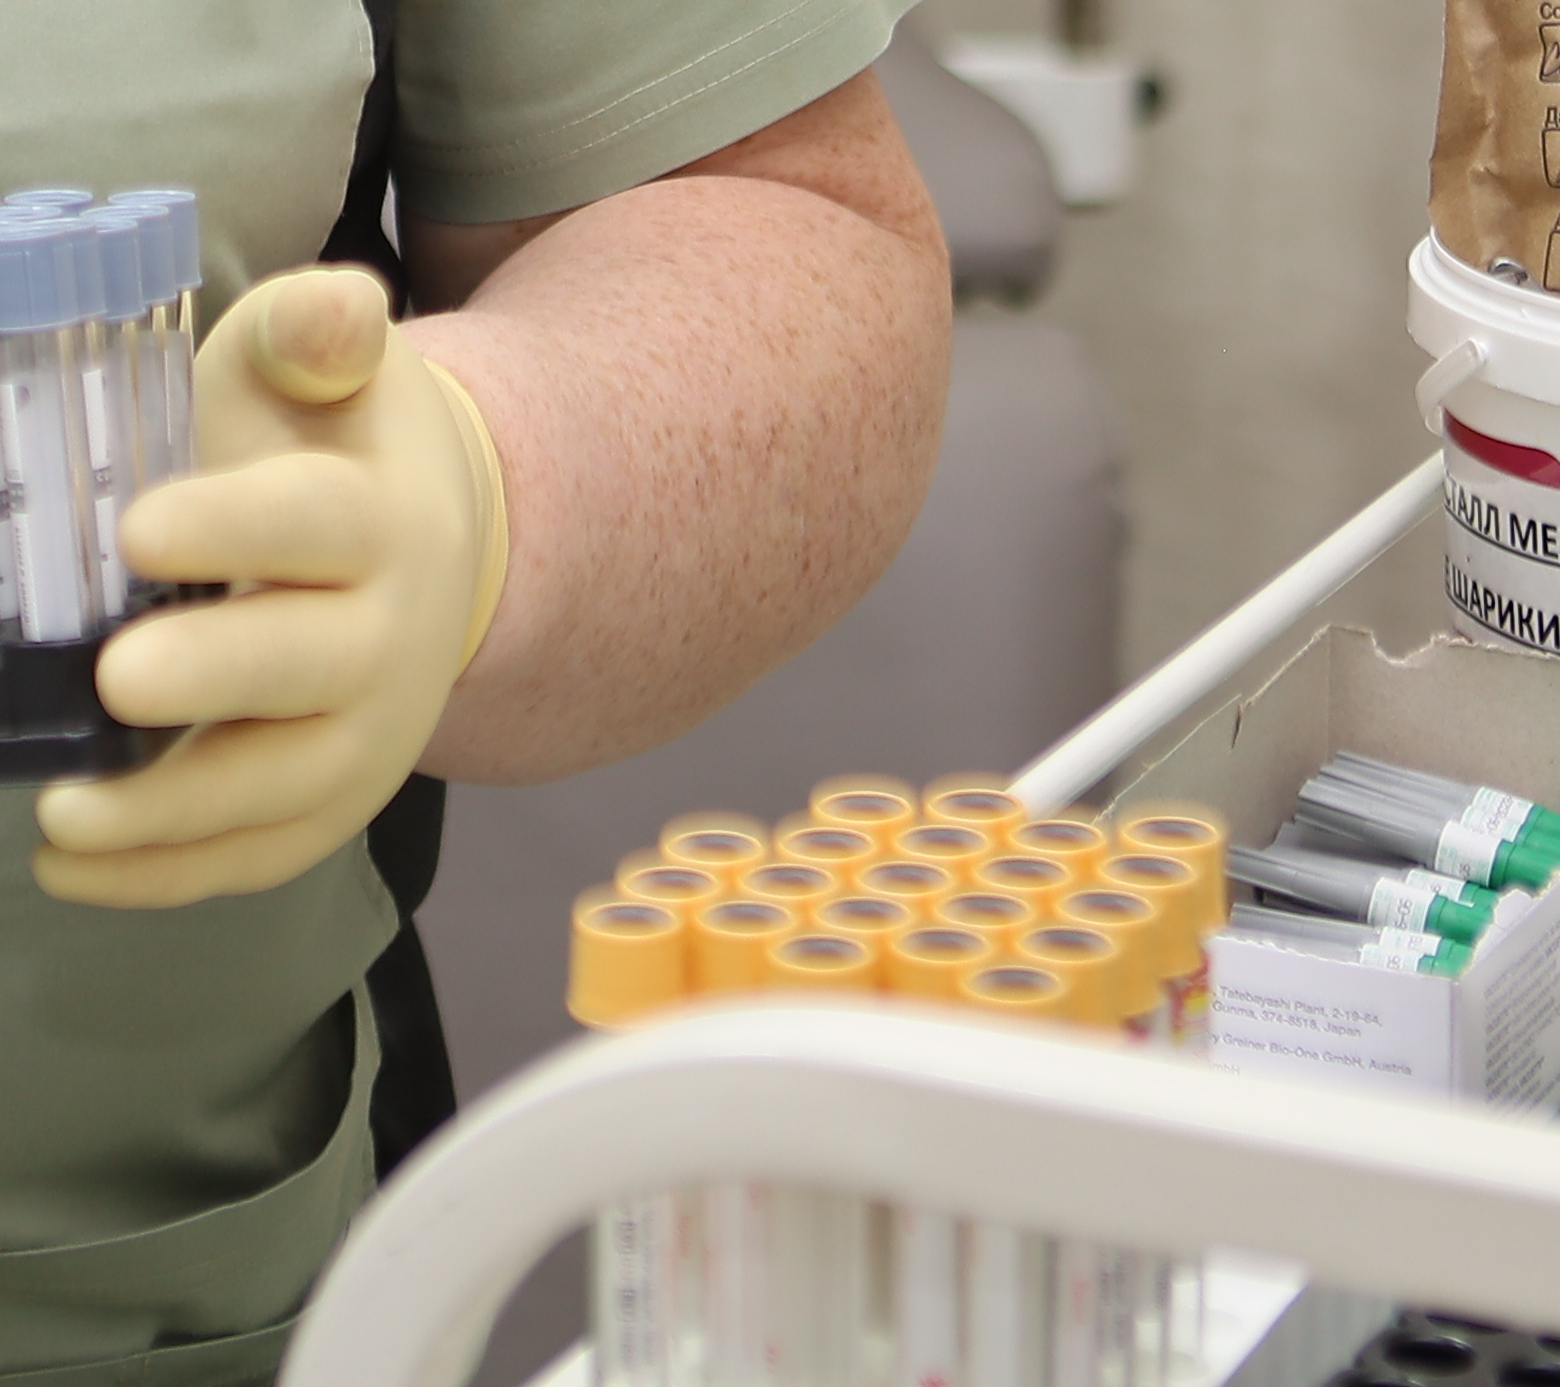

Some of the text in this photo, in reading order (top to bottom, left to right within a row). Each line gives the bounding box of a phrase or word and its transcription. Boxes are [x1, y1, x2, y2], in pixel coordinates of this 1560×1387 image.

[1219, 985, 1291, 1012] Tatebayashi
[1295, 1001, 1329, 1018] Plant,
[1323, 1022, 1362, 1039] Japan
[1223, 1033, 1267, 1052] Greiner
[1269, 1042, 1320, 1061] Bio-One
[1368, 1058, 1412, 1076] Austria
